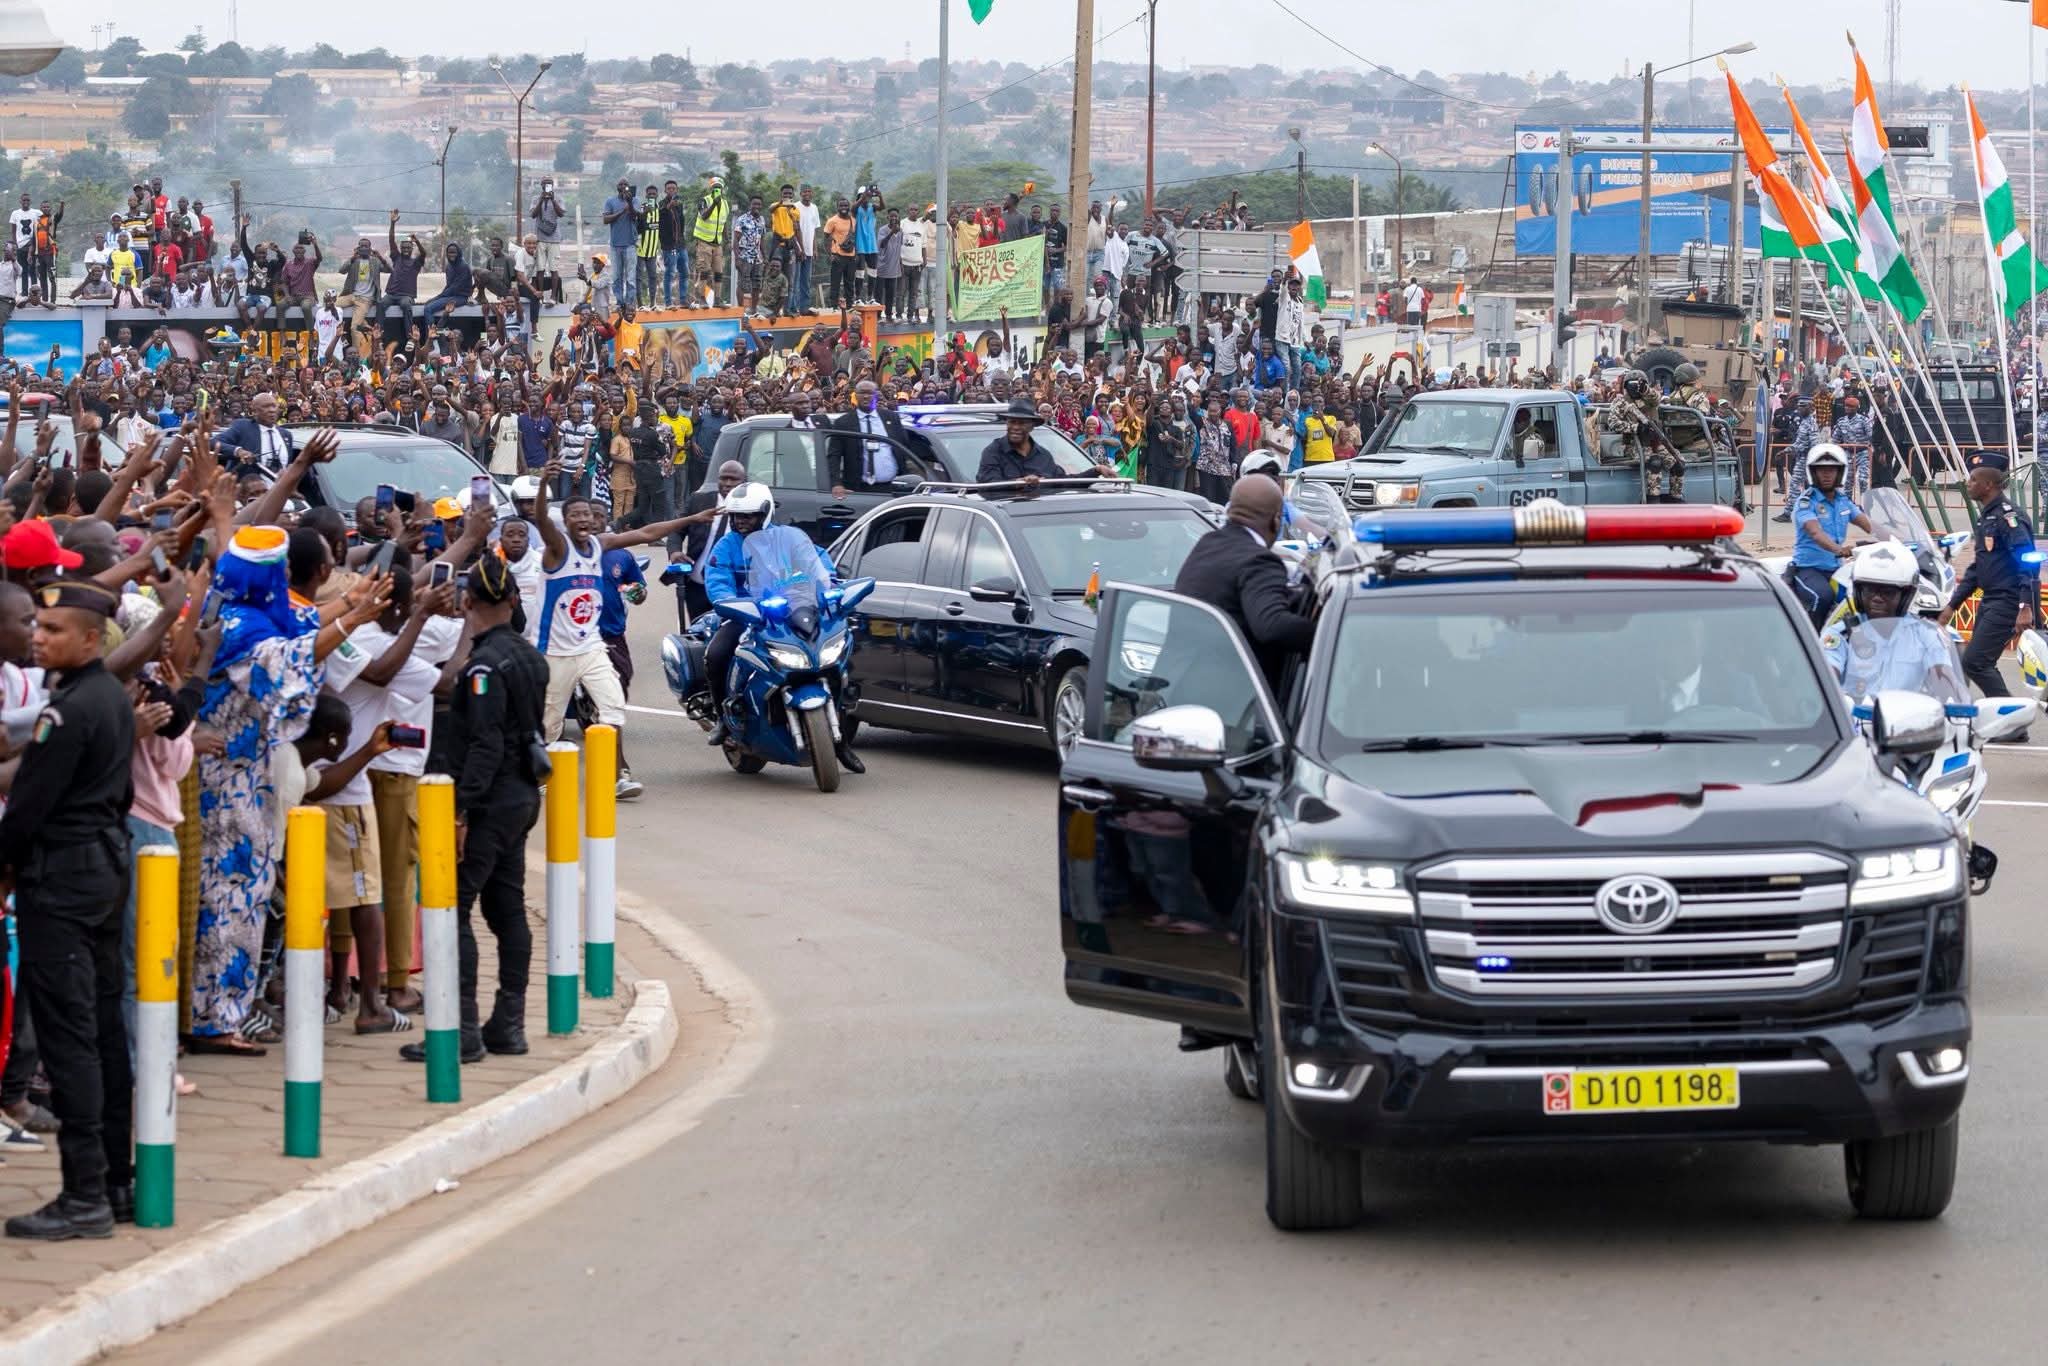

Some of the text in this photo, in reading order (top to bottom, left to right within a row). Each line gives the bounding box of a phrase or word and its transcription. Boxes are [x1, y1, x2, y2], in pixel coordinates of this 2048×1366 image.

[998, 250, 1015, 262] 2025
[1587, 1073, 1722, 1105] D10 1198
